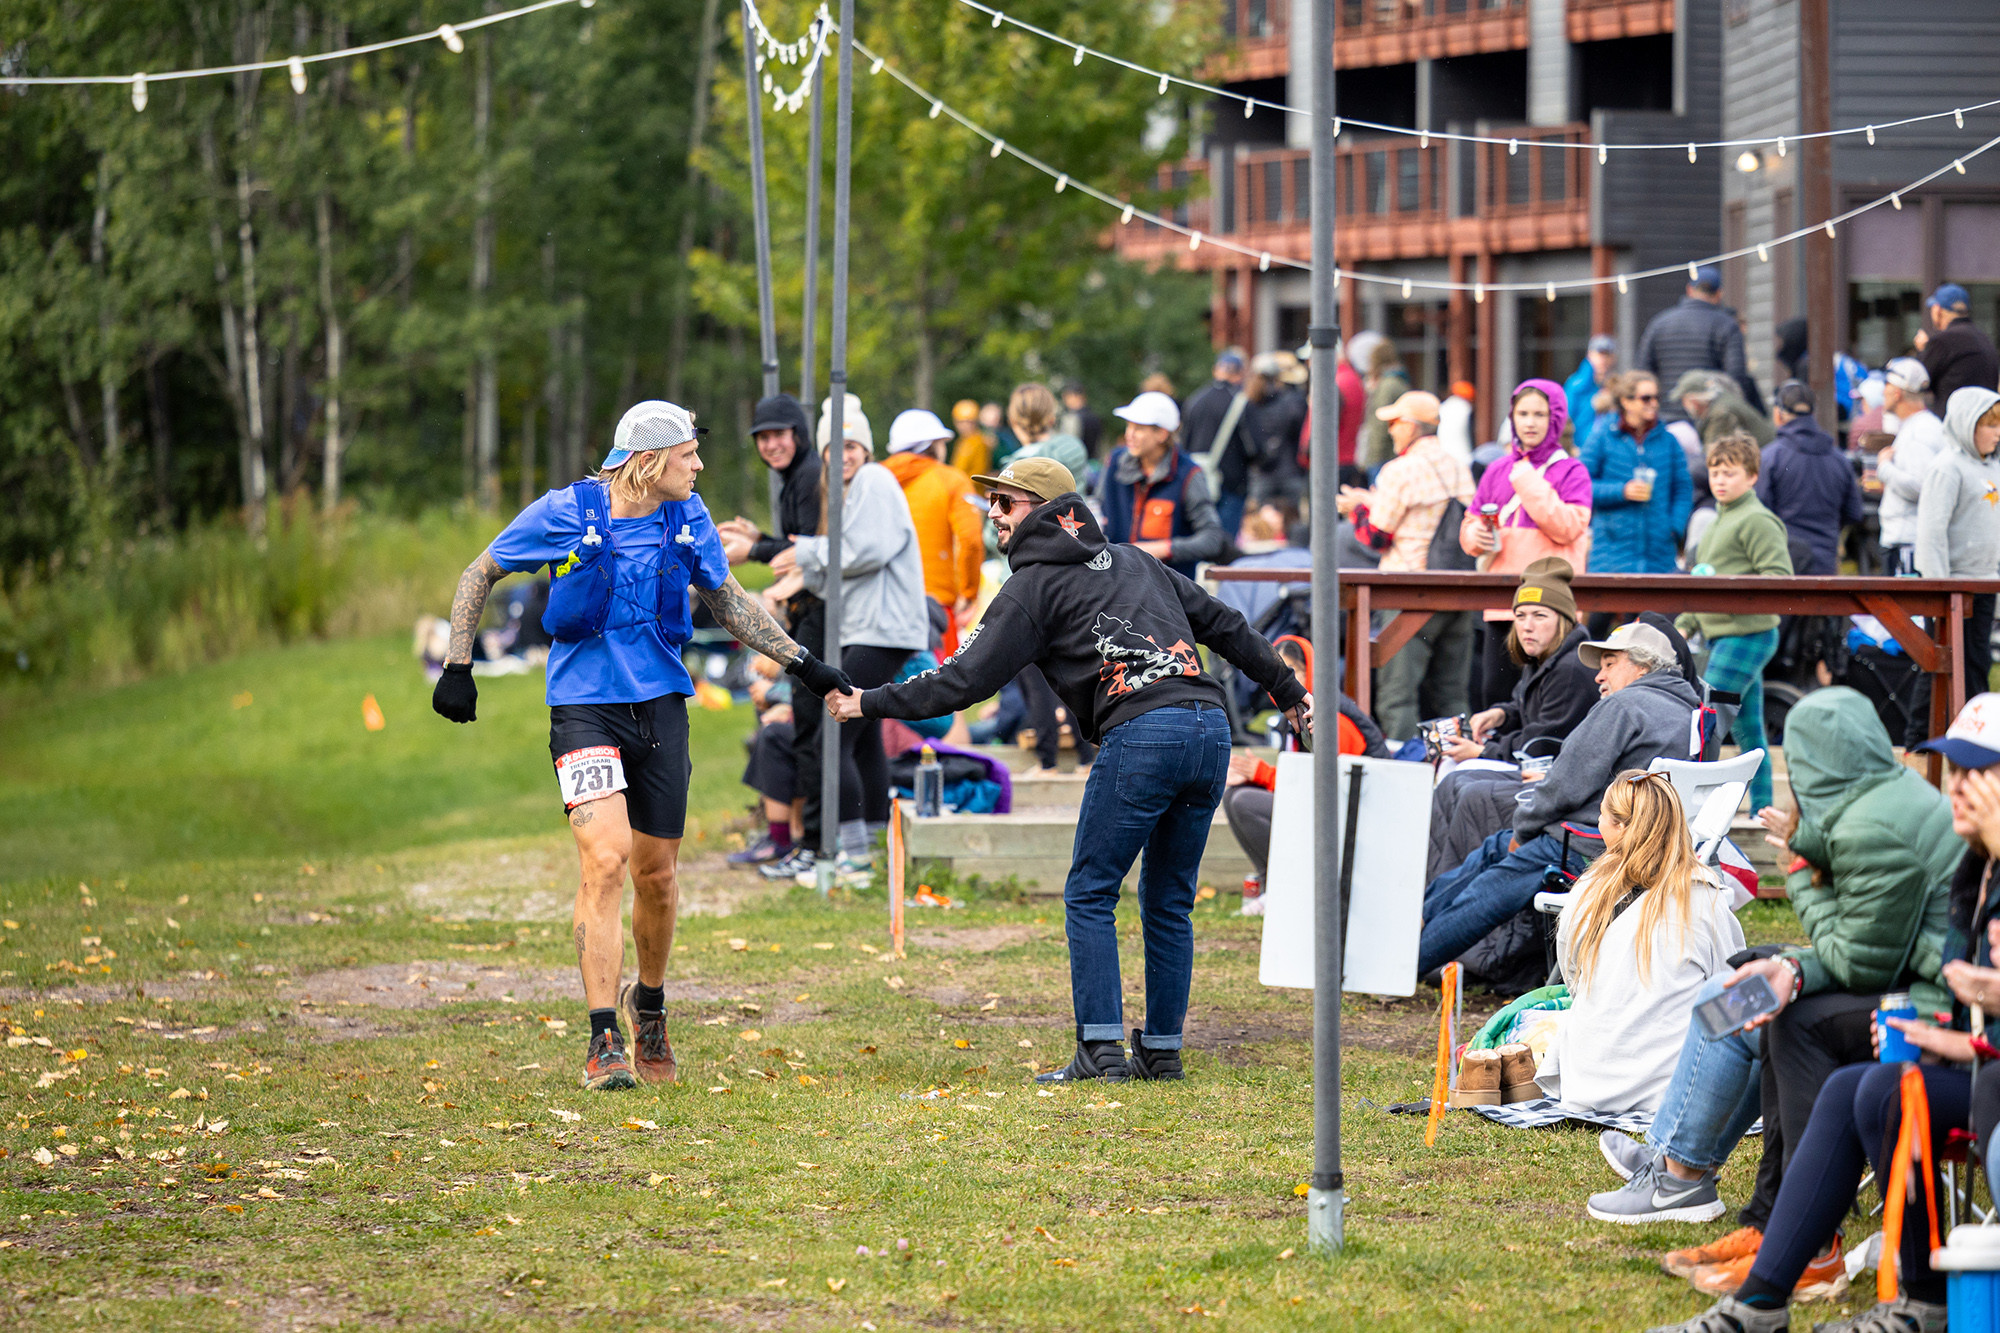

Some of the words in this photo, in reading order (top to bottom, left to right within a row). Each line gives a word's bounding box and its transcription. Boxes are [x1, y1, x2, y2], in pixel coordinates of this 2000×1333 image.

[1126, 662, 1184, 690] 100
[573, 748, 615, 760] SUPERIOR
[570, 760, 590, 770] TRENT
[571, 765, 613, 796] 237
[572, 797, 583, 806] 100
